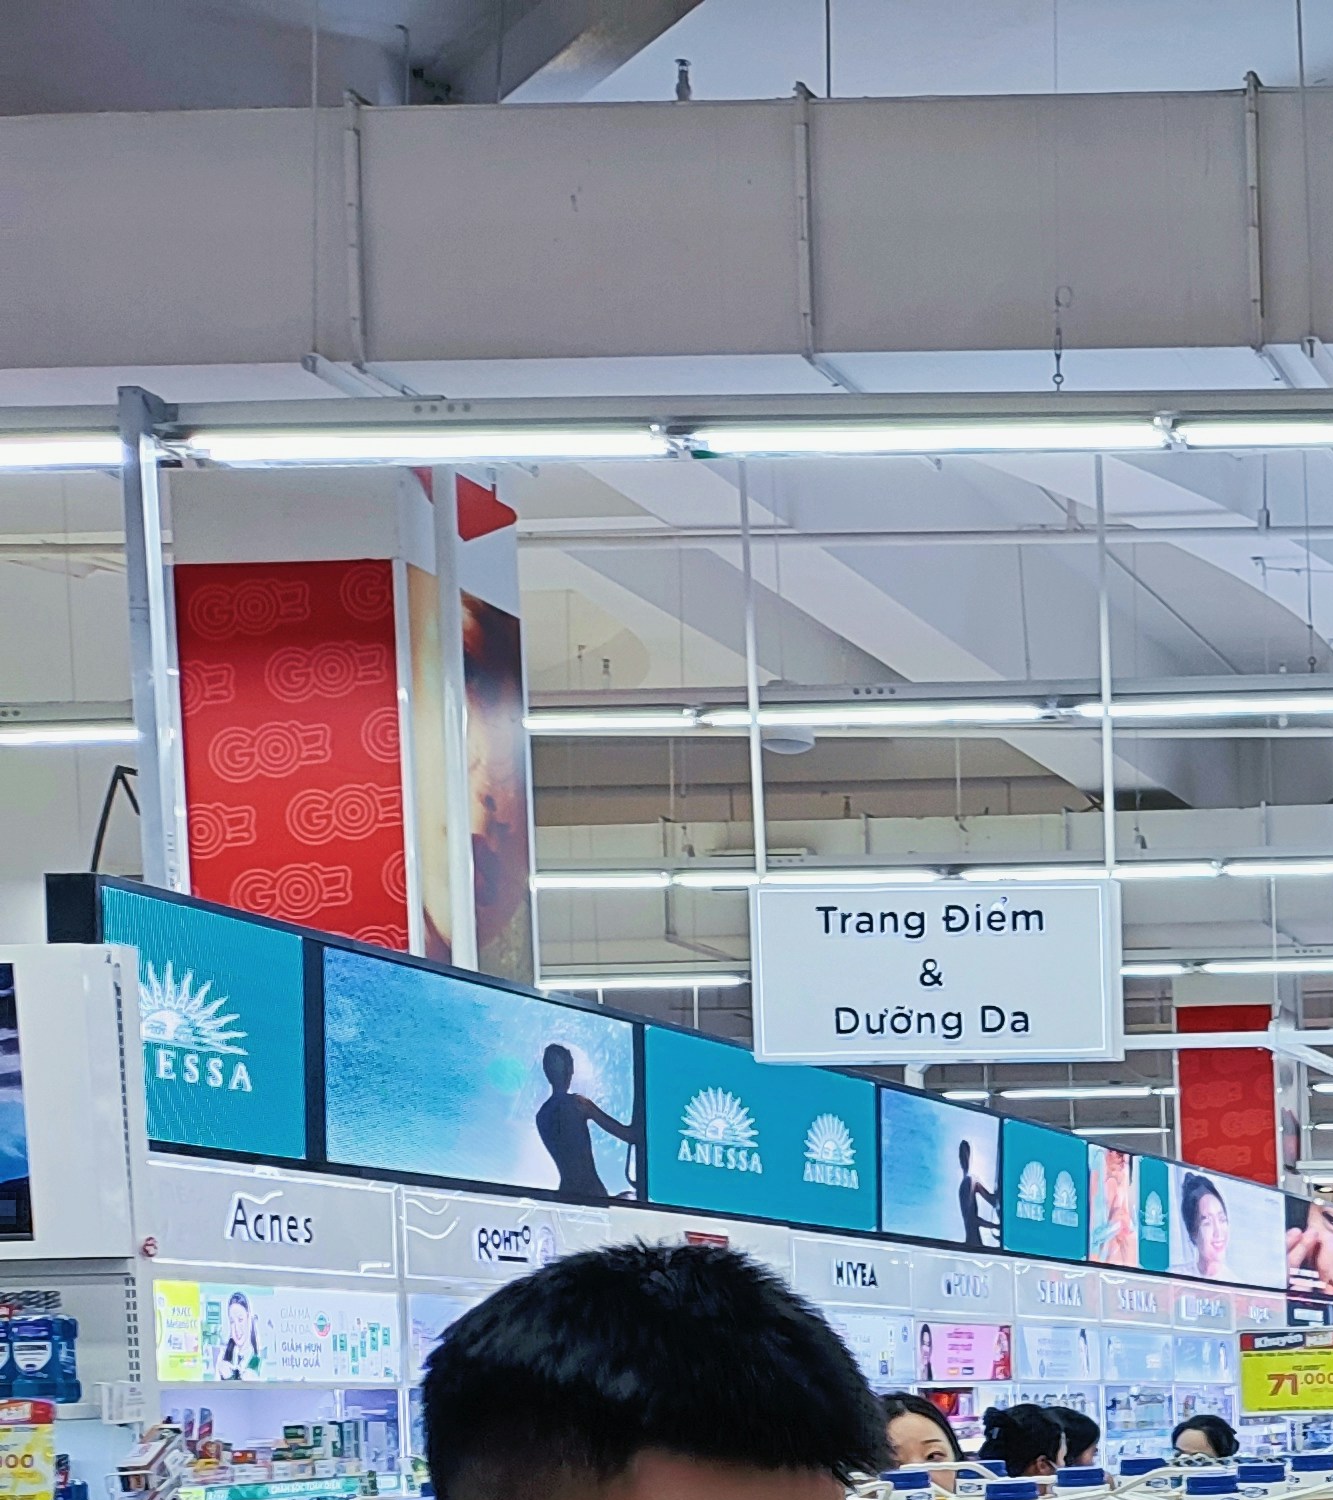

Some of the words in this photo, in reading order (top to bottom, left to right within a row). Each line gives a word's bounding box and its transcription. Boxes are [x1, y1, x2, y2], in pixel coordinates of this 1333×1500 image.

[816, 906, 926, 938] Trang
[941, 897, 1045, 933] Điểm
[919, 958, 943, 988] &
[835, 1004, 963, 1040] Dưỡng
[980, 1005, 1030, 1034] Da
[156, 1049, 252, 1092] ESSA
[678, 1138, 762, 1174] ANESSA
[226, 1199, 314, 1245] Acnes
[833, 1259, 878, 1288] NIVEA
[1038, 1280, 1082, 1306] SENKA
[1119, 1288, 1158, 1314] SENKA
